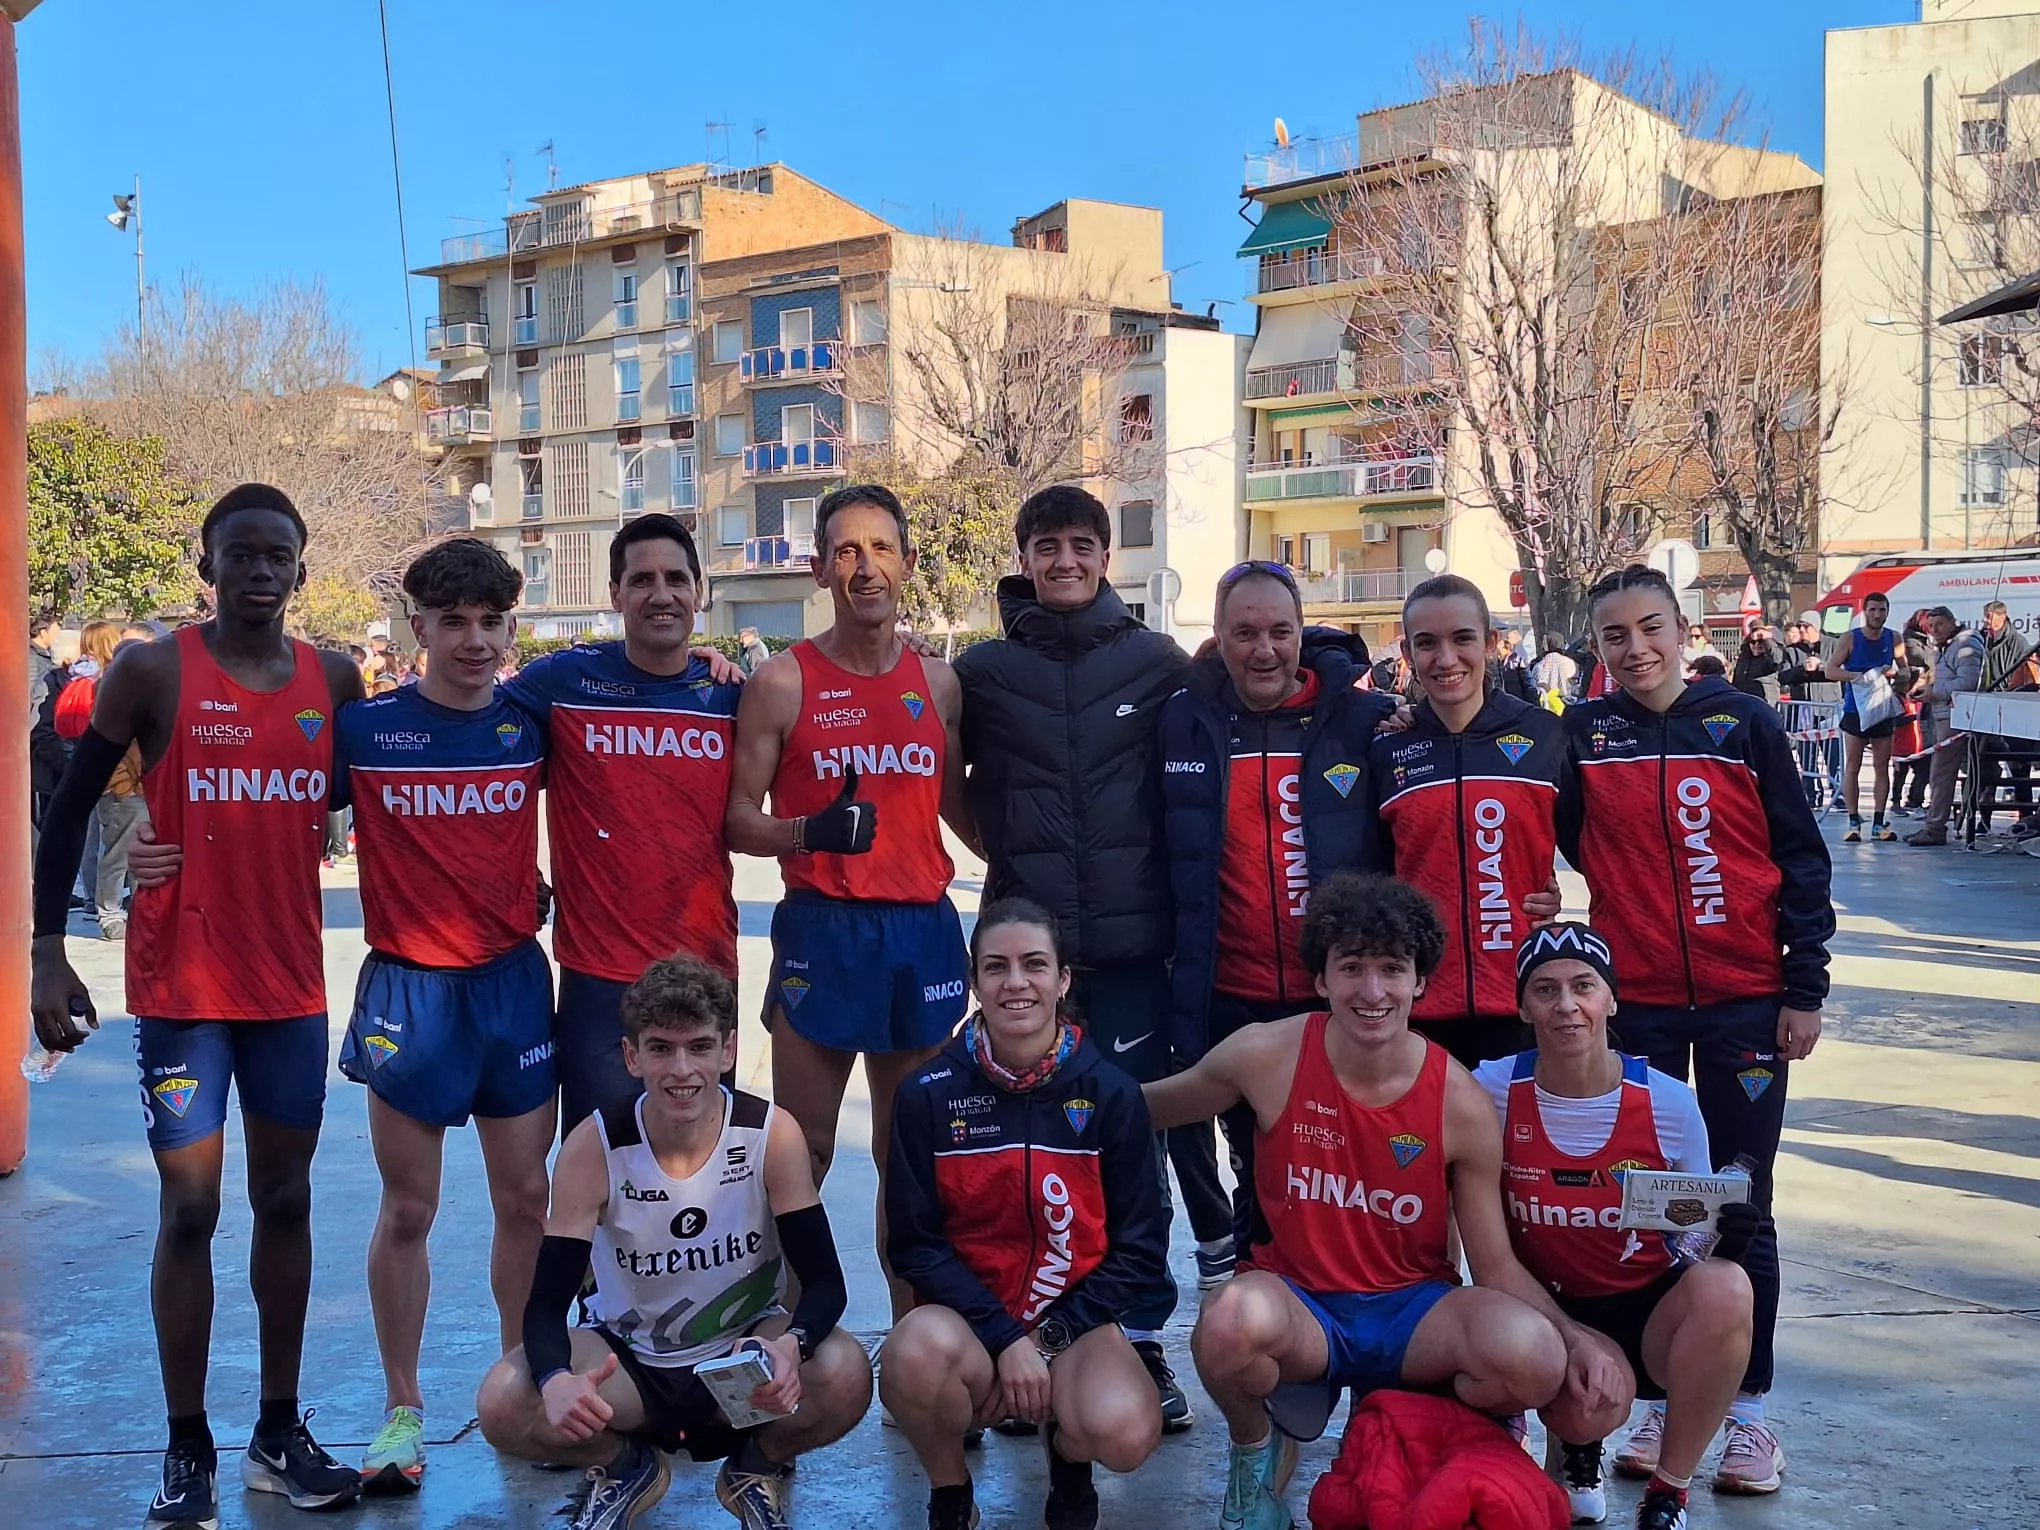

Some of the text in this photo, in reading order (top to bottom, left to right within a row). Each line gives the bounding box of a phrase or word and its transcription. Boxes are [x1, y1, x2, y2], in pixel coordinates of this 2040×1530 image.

[1938, 576, 2009, 587] AMBULANCA
[214, 701, 238, 712] barri
[830, 688, 852, 698] barri
[813, 707, 867, 724] Huesca
[191, 723, 253, 738] Huesca
[374, 731, 431, 743] Huesca
[585, 723, 724, 760] HINACO
[812, 742, 936, 780] HINACO
[1165, 761, 1205, 774] HINACO
[187, 767, 326, 802] HINACO
[382, 779, 527, 816] HINACO
[1277, 774, 1311, 917] HINACO
[1677, 776, 1727, 925] HINACO
[1474, 798, 1514, 950] HINACO
[519, 1041, 558, 1070] HINA
[931, 1068, 952, 1080] barri
[948, 1095, 996, 1110] Huesca
[1317, 1103, 1338, 1117] barri
[1293, 1123, 1345, 1146] Huesca
[1287, 1162, 1423, 1225] HINACO
[1508, 1191, 1622, 1229] hinac
[616, 1231, 762, 1277] etxenike
[1022, 1173, 1074, 1321] HINACO
